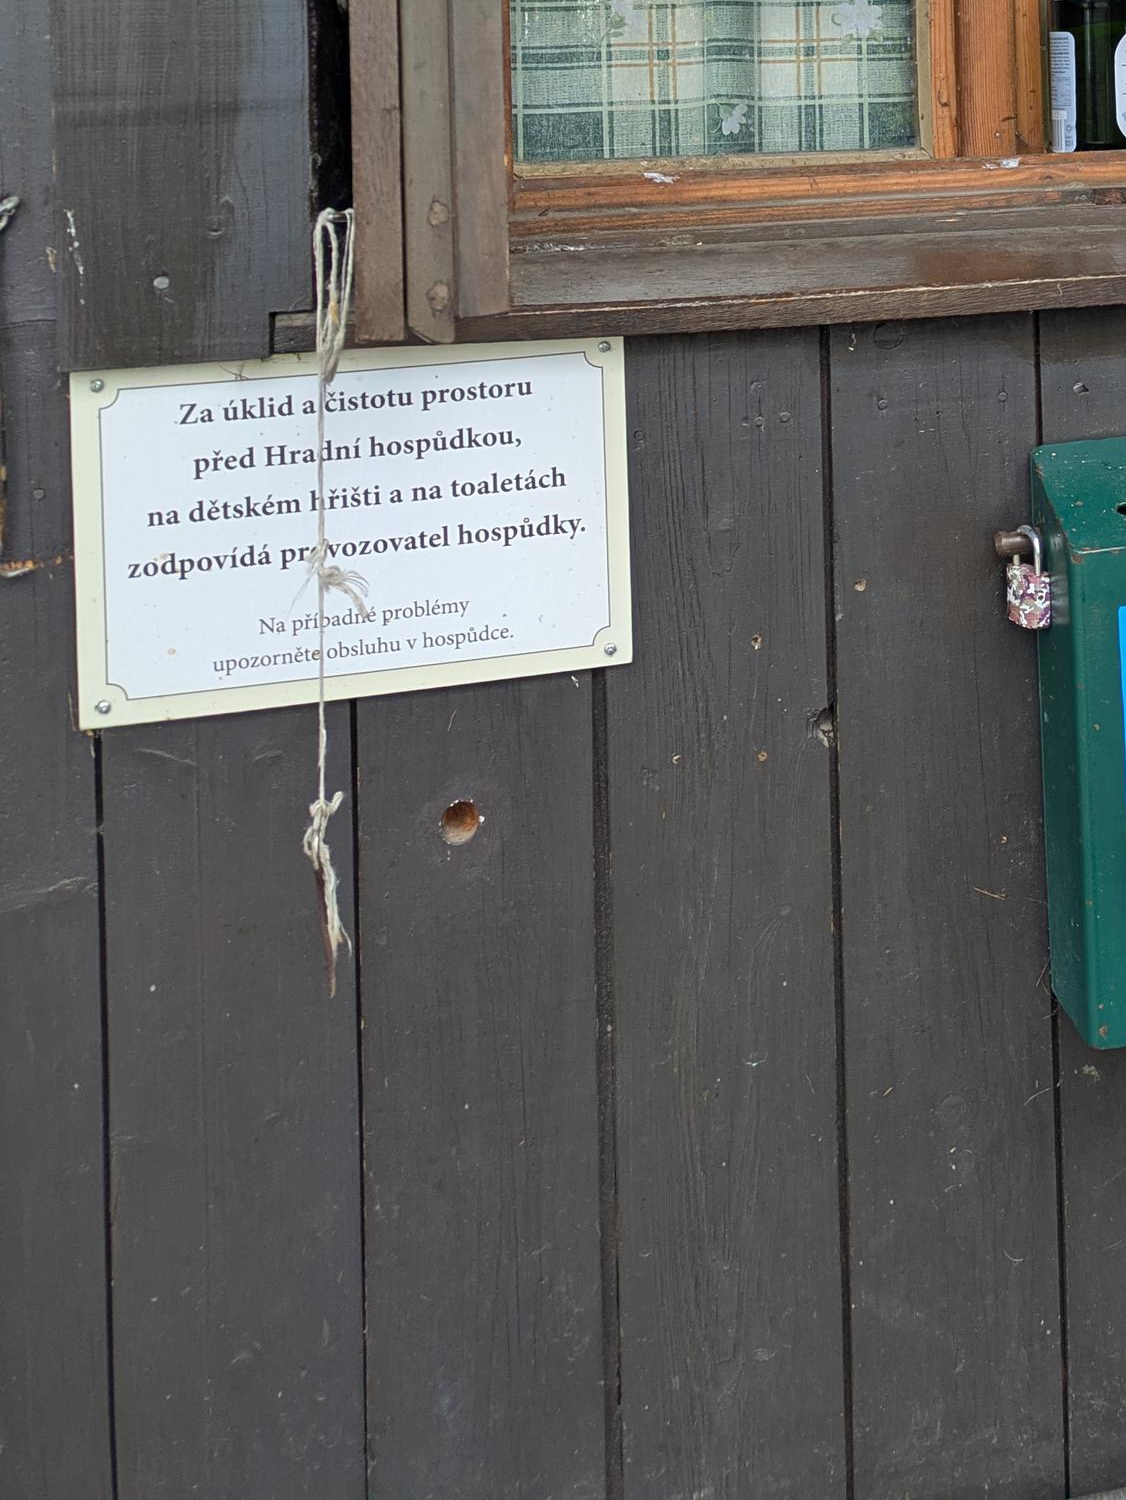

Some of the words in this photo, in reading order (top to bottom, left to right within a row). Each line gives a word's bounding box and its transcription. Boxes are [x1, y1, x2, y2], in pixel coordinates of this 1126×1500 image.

[178, 402, 214, 426] Za
[222, 393, 294, 422] úklid
[301, 399, 317, 417] a
[323, 387, 415, 414] čistotu
[421, 379, 534, 414] prostoru
[192, 445, 256, 480] před
[264, 437, 362, 467] Hradní
[368, 428, 523, 468] hospůdkou,
[146, 506, 181, 528] na
[187, 493, 302, 524] dětském
[309, 485, 383, 512] hřišti
[388, 487, 404, 504] a
[410, 482, 443, 502] na
[450, 467, 567, 498] toaletách
[126, 542, 272, 582] zodpovídá
[456, 511, 587, 551] hospůdky.
[258, 616, 287, 636] Na
[291, 606, 377, 637] případné
[381, 597, 471, 628] problémy
[212, 645, 321, 675] upozorněte
[326, 636, 402, 661] obsluhu
[407, 636, 419, 650] v
[422, 623, 516, 657] hospůdce.
